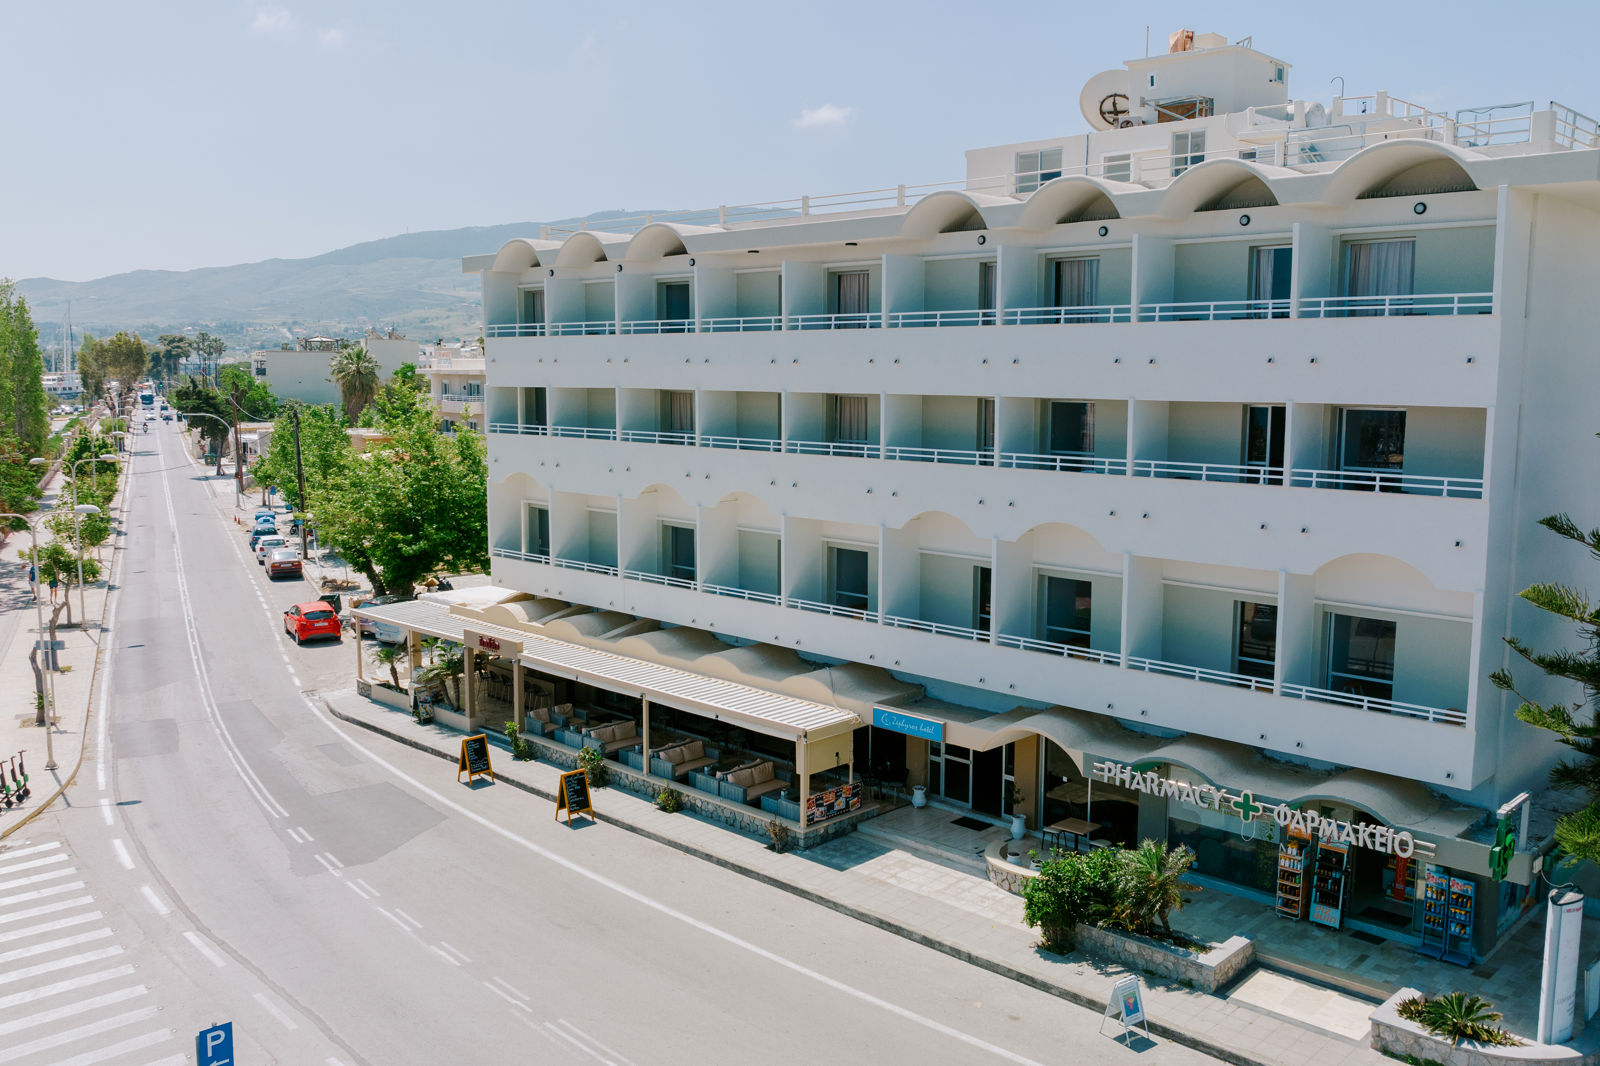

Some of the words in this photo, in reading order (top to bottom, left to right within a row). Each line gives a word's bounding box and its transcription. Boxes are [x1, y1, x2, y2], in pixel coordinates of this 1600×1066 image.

[919, 723, 934, 734] hotel
[1103, 761, 1227, 811] PHARMACY
[1273, 803, 1414, 859] ΦΑΡΜΑΚΕΙΟ
[206, 1030, 225, 1057] P
